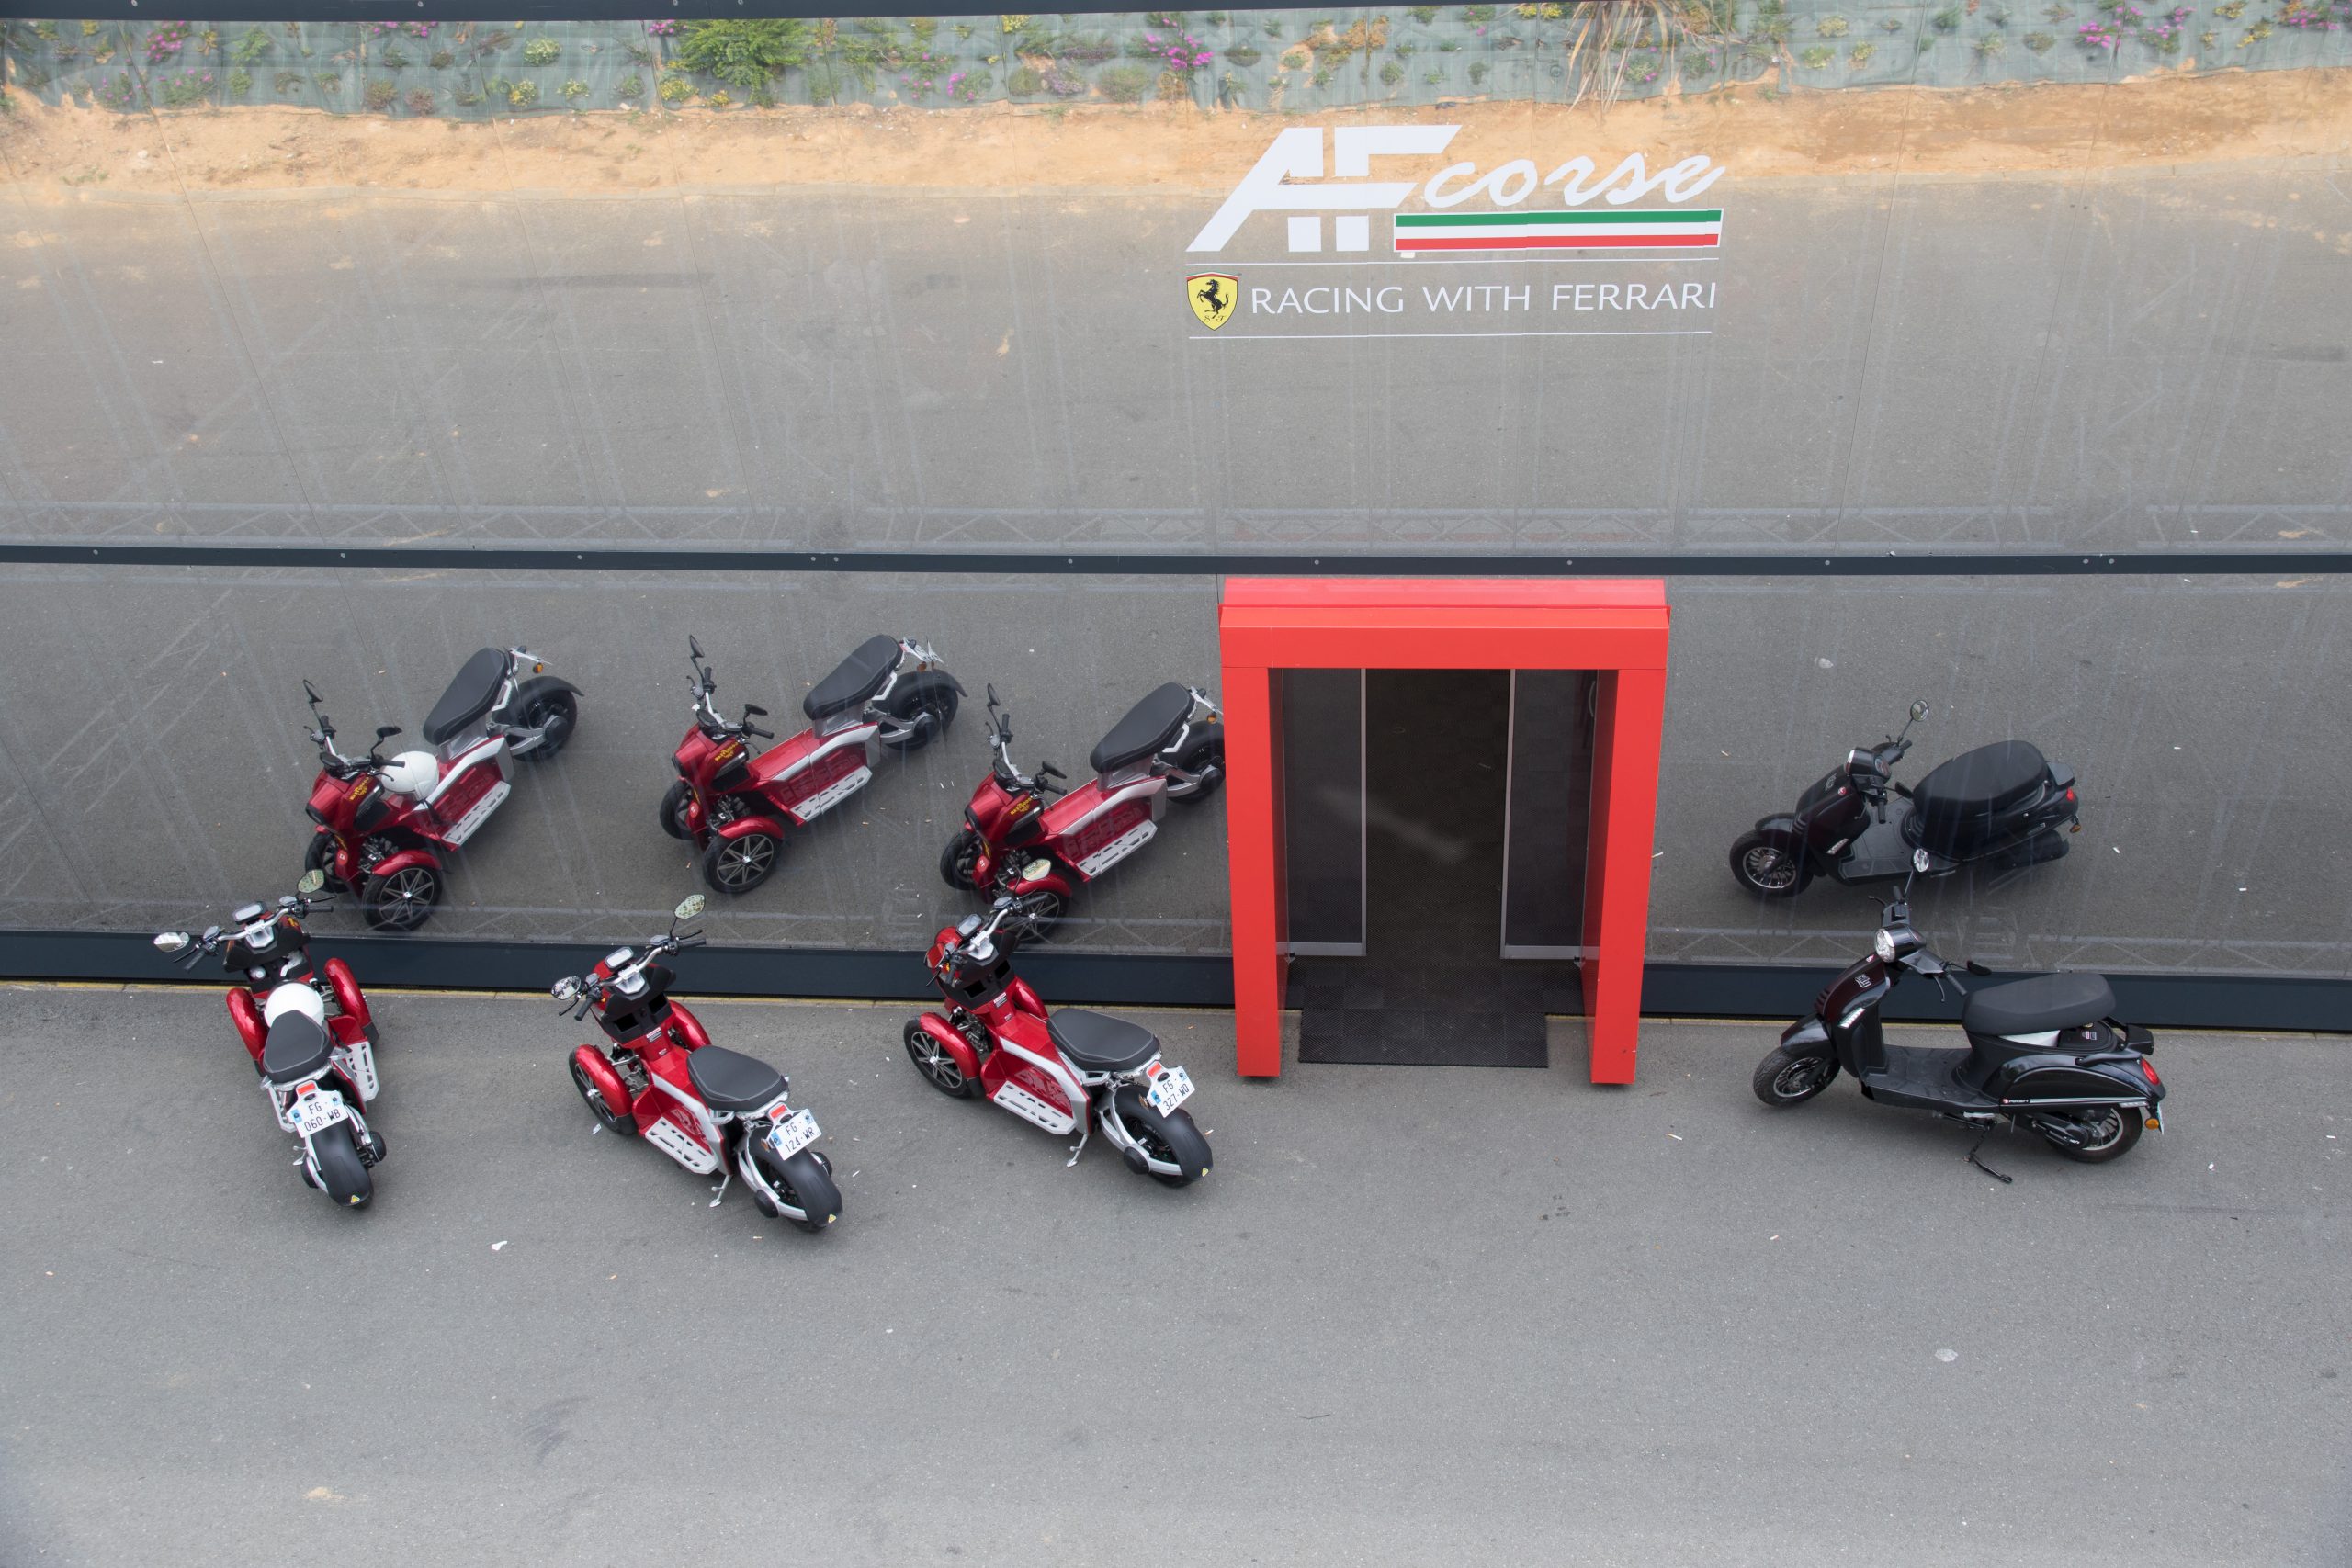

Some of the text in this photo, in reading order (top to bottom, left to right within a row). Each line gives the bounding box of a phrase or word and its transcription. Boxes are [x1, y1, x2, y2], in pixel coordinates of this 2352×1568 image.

[1423, 153, 1727, 209] corse
[1250, 281, 1718, 315] RACING WITH FERRARI
